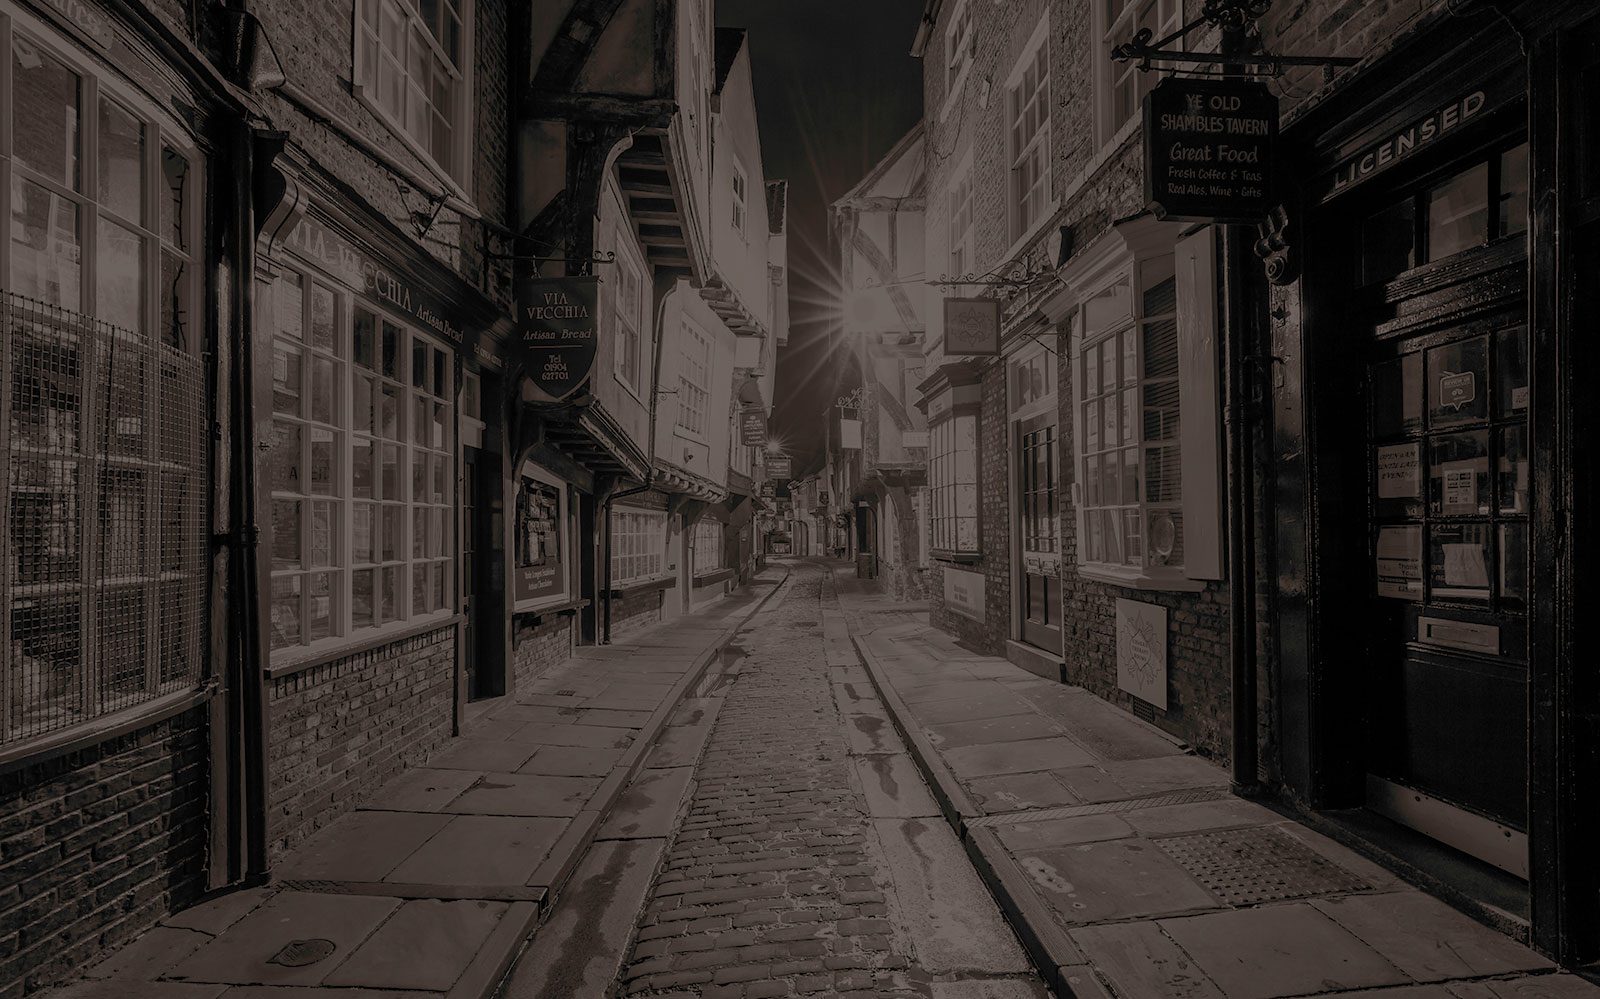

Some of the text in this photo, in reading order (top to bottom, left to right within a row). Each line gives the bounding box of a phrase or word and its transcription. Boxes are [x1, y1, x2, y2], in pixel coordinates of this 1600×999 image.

[1186, 94, 1241, 111] YE OLD
[1161, 113, 1269, 136] SHAMBLES TAVERN
[1333, 90, 1487, 190] LICENSED
[1170, 141, 1259, 163] Great Food
[1168, 166, 1196, 179] Fresh
[1198, 168, 1227, 180] Coffee
[1241, 170, 1262, 182] Teas
[1168, 182, 1185, 195] Real
[1210, 185, 1232, 197] Wine
[1241, 186, 1262, 198] Gifts
[291, 218, 329, 263] VIA
[416, 303, 444, 332] Artisan
[443, 319, 464, 344] Bread
[527, 292, 589, 320] VIA VECCHIA
[523, 328, 592, 340] Artisan Bread
[543, 363, 568, 372] 01904
[548, 354, 561, 364] Tel
